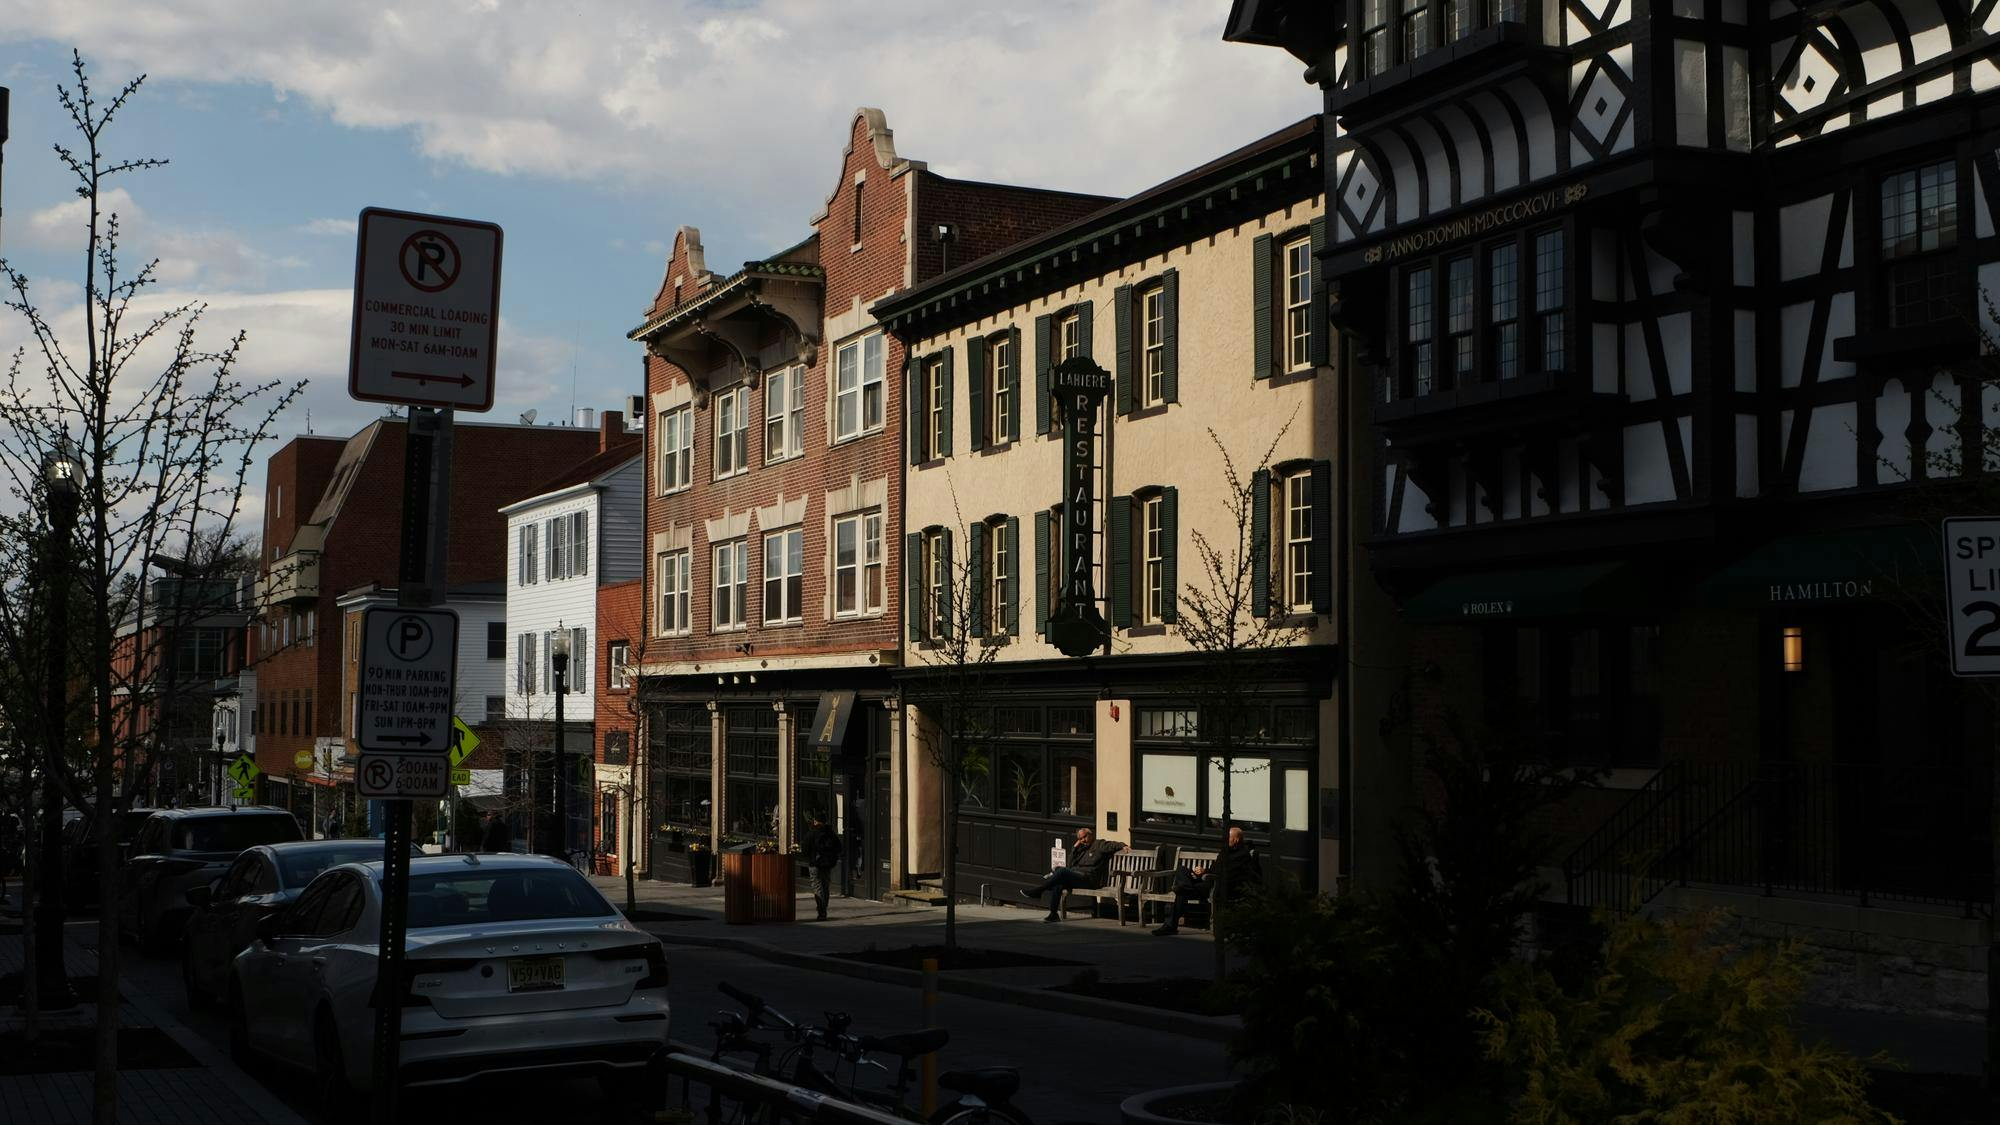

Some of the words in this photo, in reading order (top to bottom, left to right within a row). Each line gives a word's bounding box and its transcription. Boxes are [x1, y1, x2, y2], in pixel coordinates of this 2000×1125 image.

[1389, 234, 1424, 257] ANNO
[1427, 218, 1471, 247] DOMINI
[1474, 191, 1556, 232] MDCCCXCVI
[365, 300, 437, 320] COMMERCIAL
[441, 309, 488, 325] LOADING
[391, 320, 405, 334] 30
[409, 323, 429, 336] MIN
[433, 325, 462, 339] LIMIT
[371, 337, 421, 353] MON-SAT
[423, 343, 478, 359] 6AM-10AM
[1059, 371, 1107, 389] LAHIERE
[1075, 394, 1089, 620] RESTAURANT
[1769, 579, 1872, 601] HAMILTON
[1471, 601, 1505, 615] ROLEX
[368, 667, 384, 679] 90
[385, 669, 402, 680] MIN
[405, 670, 446, 682] PARKING
[365, 684, 407, 697] MON-THUR
[409, 686, 449, 698] 10AM-8PM
[365, 700, 400, 712] FRI-SAT
[402, 701, 448, 714] 10AM-9PM
[374, 716, 393, 728] SUN
[396, 717, 436, 729] 1PM-8PM
[395, 776, 438, 791] 6:00AM
